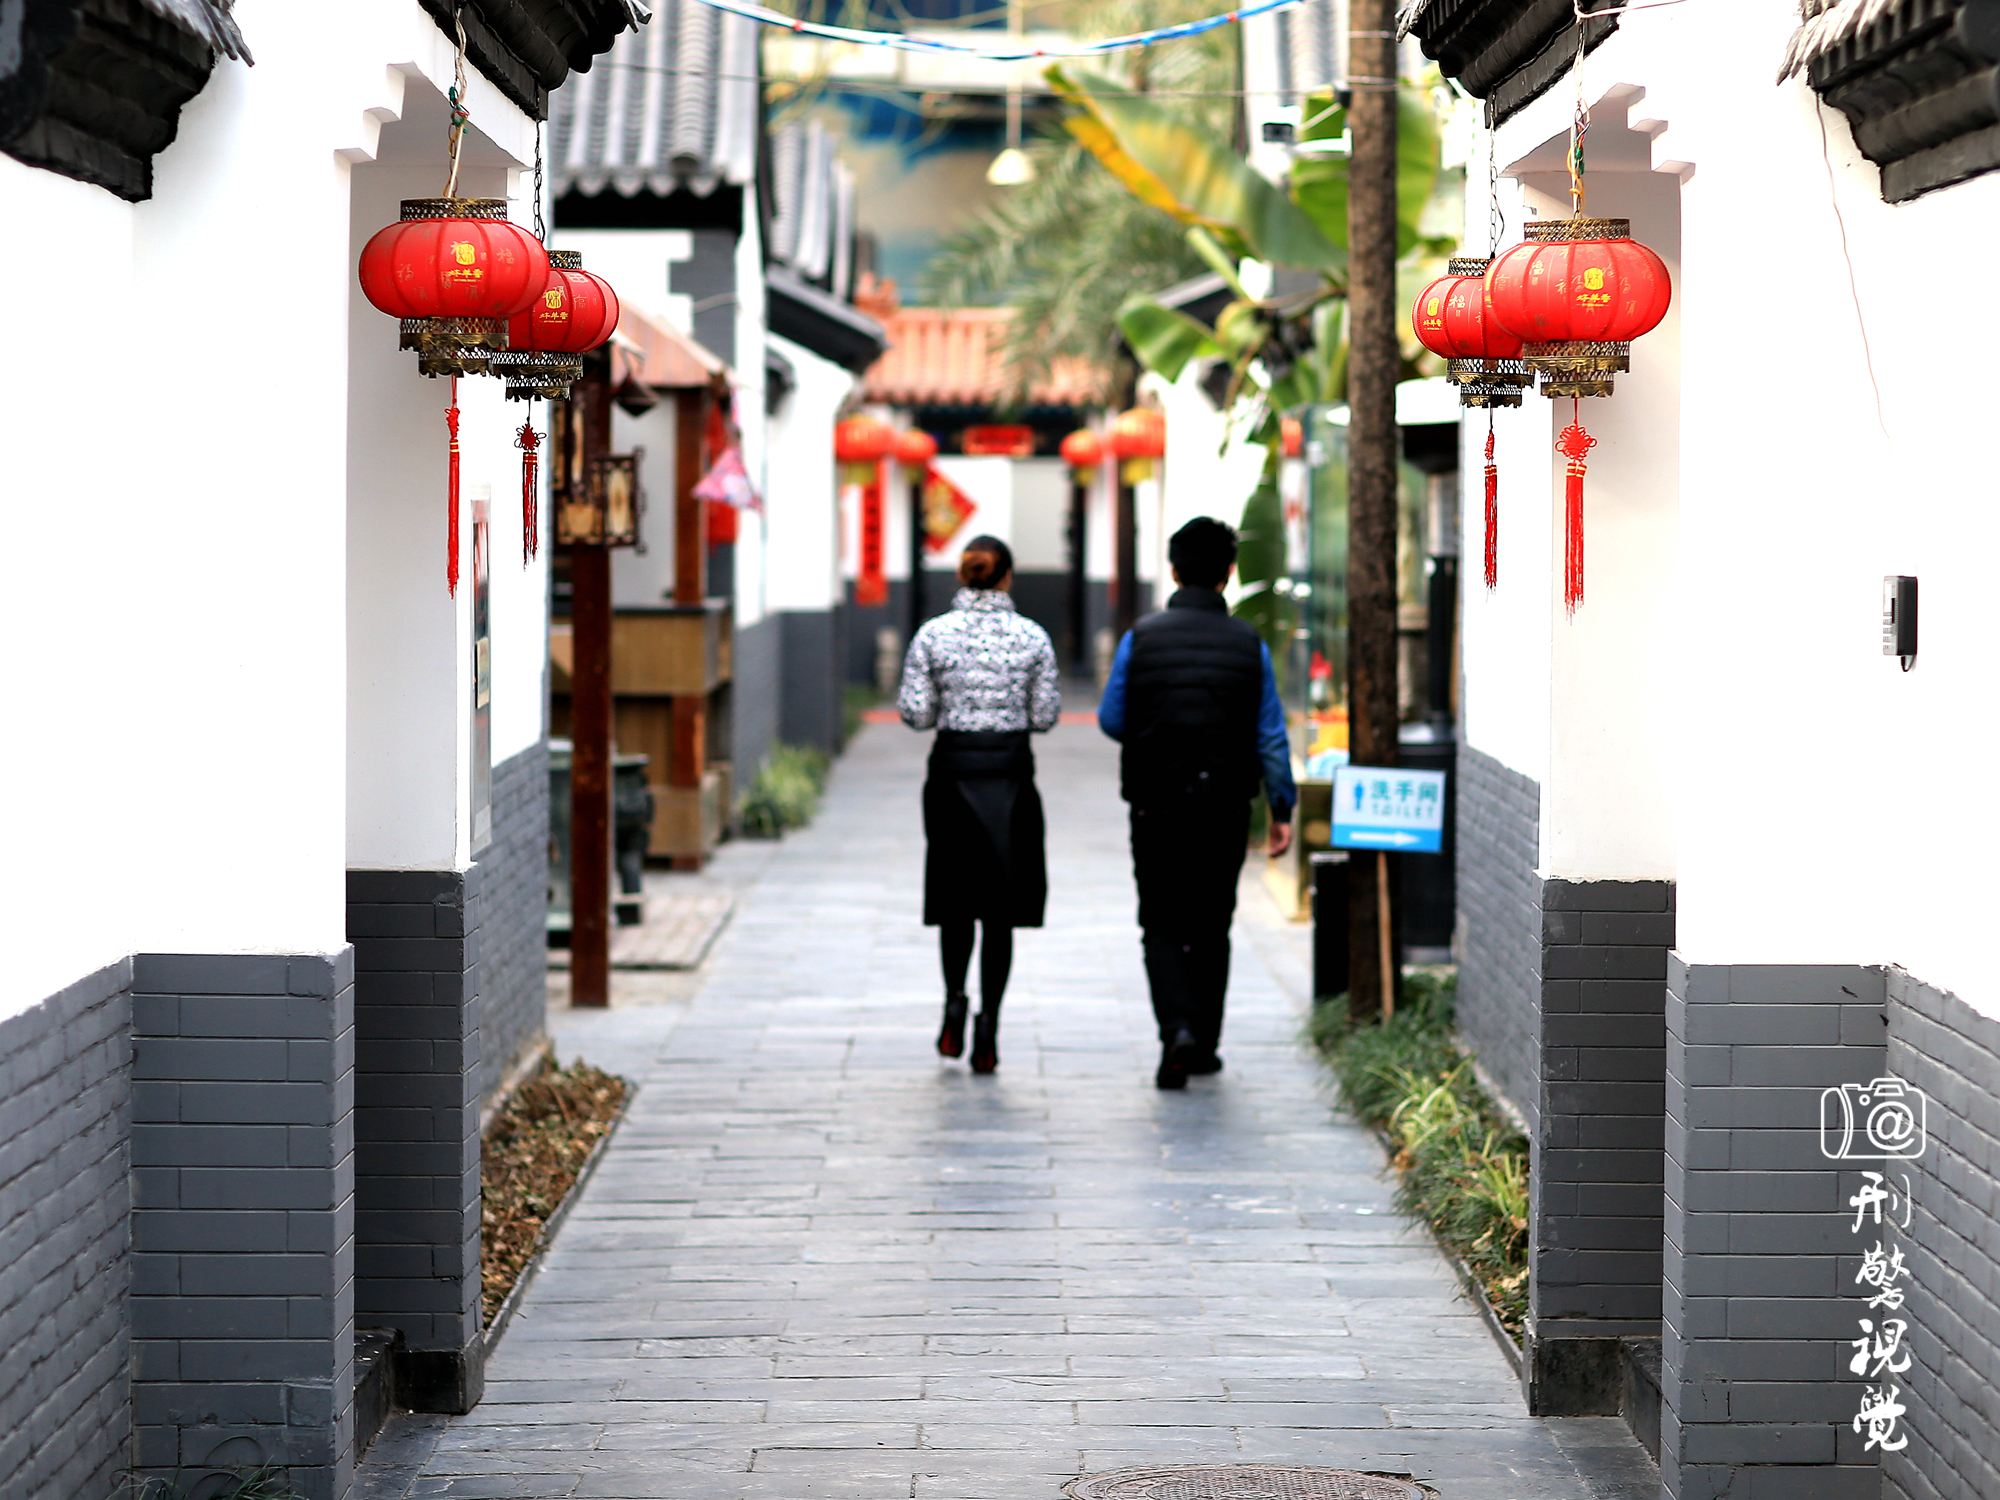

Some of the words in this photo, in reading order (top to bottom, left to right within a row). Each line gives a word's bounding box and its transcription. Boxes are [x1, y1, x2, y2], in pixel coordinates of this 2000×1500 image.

[1371, 780, 1438, 802] 洗手间
[1373, 804, 1434, 817] TOILET
